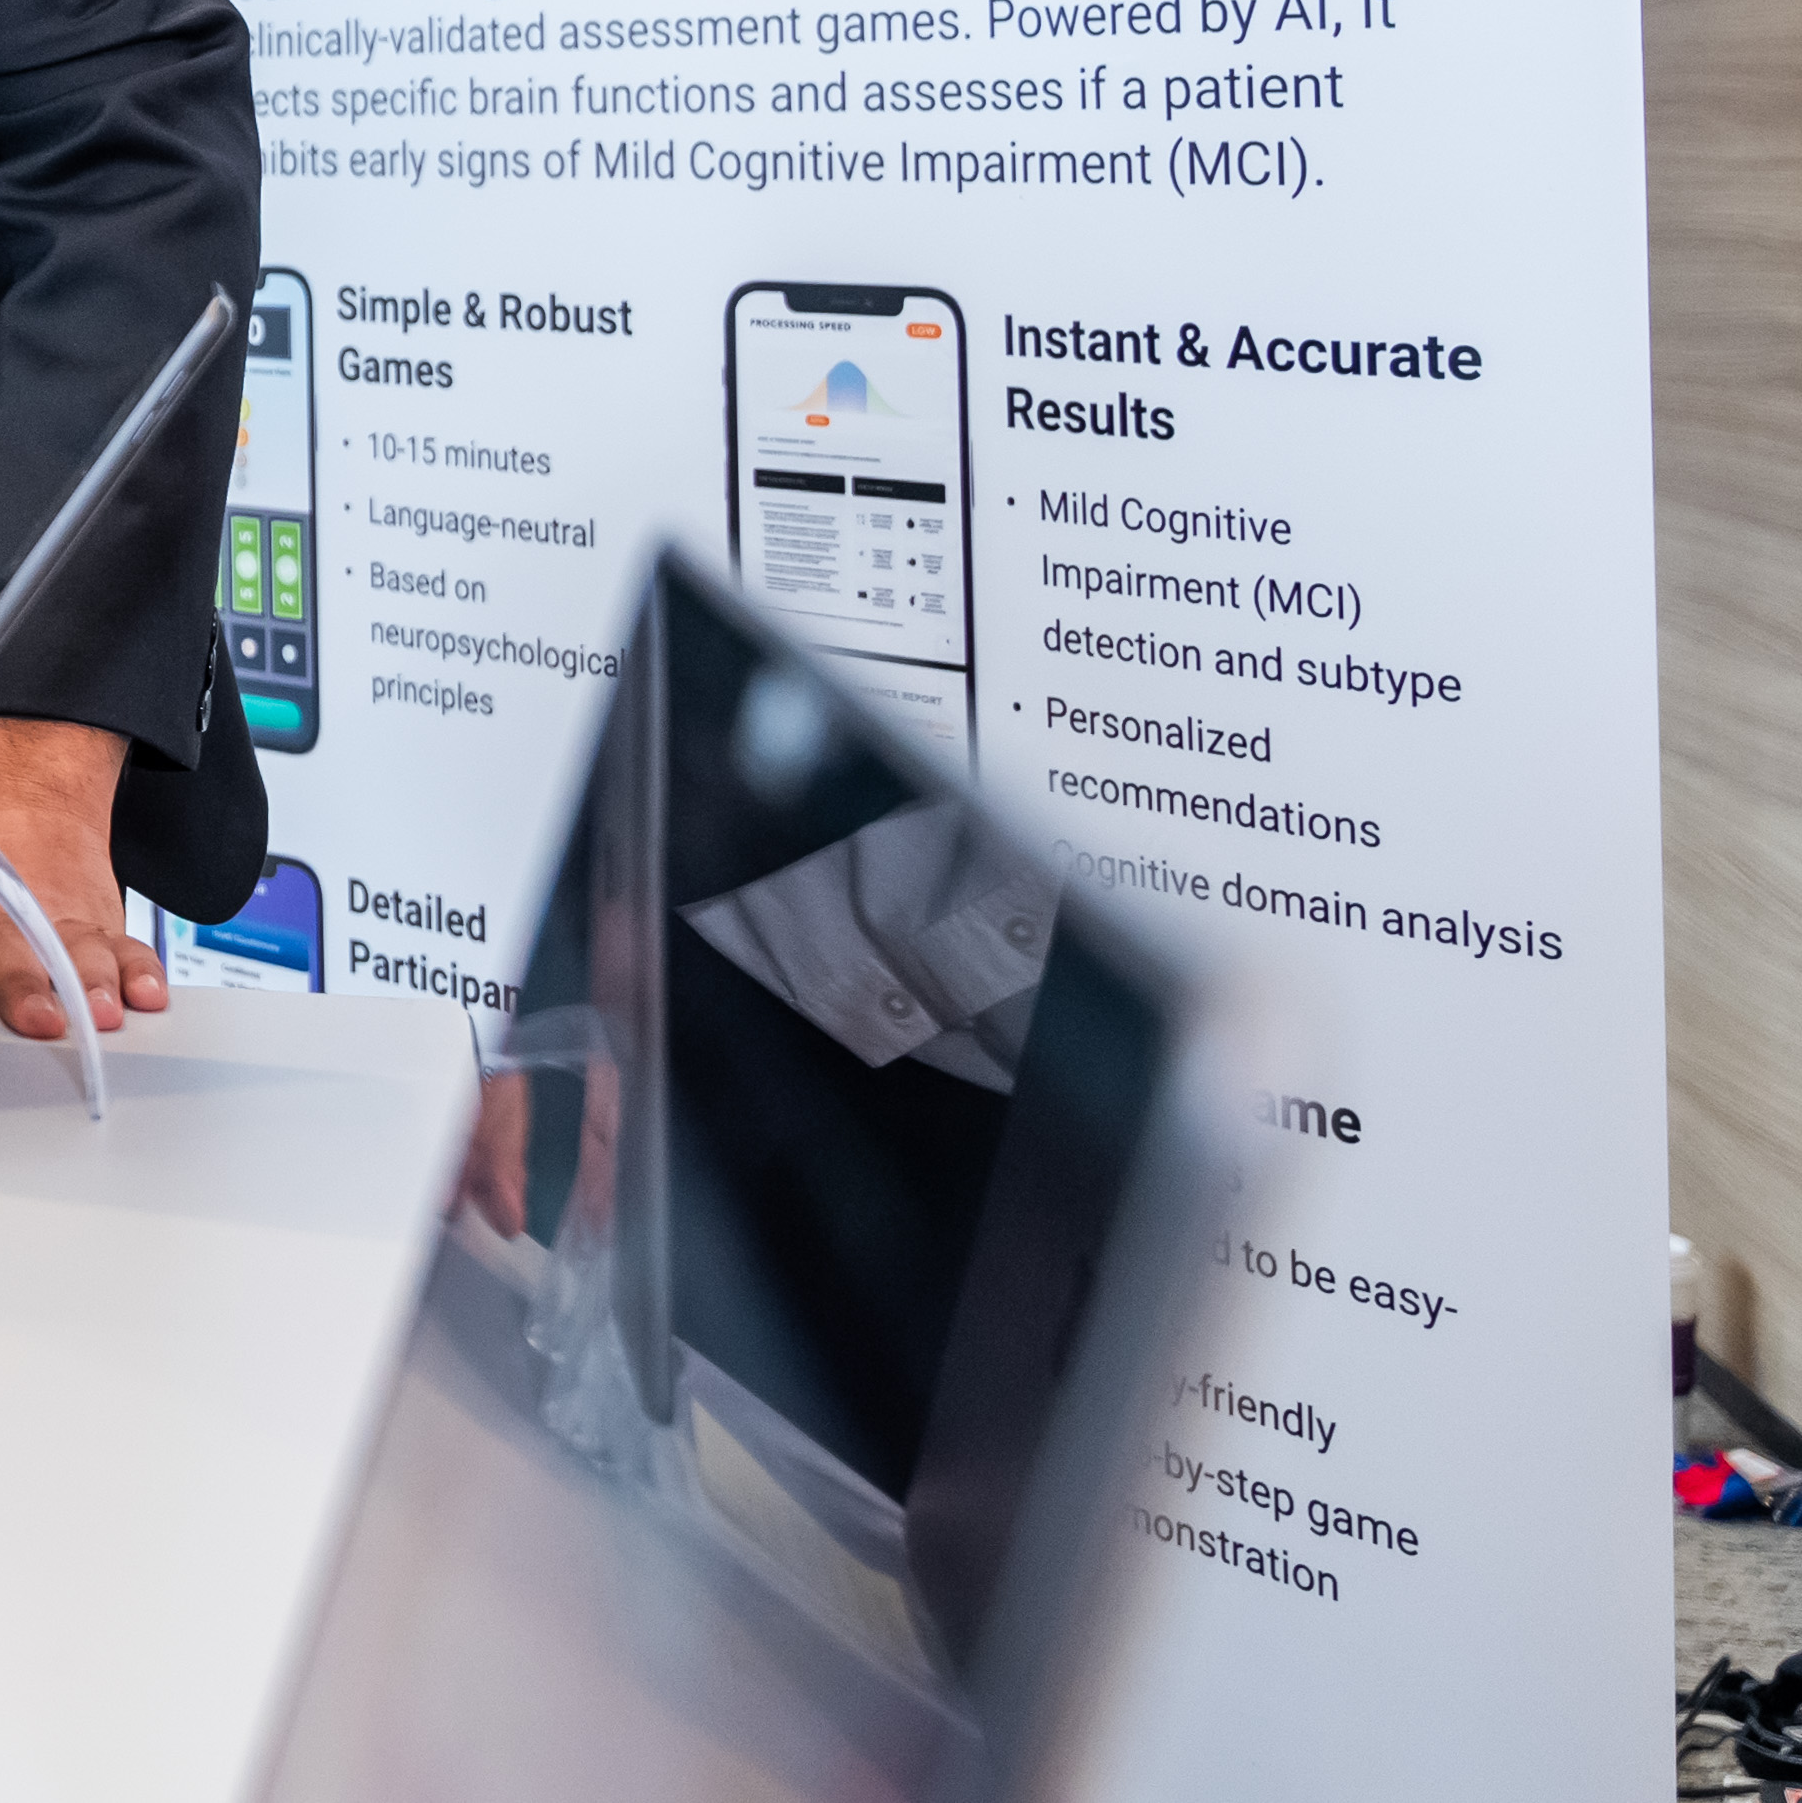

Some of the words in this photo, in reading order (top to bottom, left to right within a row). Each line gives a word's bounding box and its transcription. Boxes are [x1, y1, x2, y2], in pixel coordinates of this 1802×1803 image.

[559, 7, 801, 50] assessment
[816, 7, 972, 53] games.
[254, 85, 320, 117] ects
[331, 78, 458, 125] specific
[469, 79, 559, 116] brain
[572, 74, 756, 115] functions
[770, 70, 848, 113] and
[863, 77, 1064, 112] assesses
[1079, 64, 1106, 110] if
[1122, 76, 1148, 110] a
[1164, 64, 1344, 121] patient
[349, 141, 425, 187] early
[436, 142, 530, 188] signs
[543, 139, 582, 179] of
[594, 140, 675, 180] Mild
[688, 140, 885, 191] Cognitive
[901, 141, 1152, 193] Impairment
[1169, 135, 1325, 199] (MCI).
[337, 285, 452, 334] Simple
[463, 292, 487, 329] &
[498, 293, 633, 336] Robust
[750, 319, 815, 330] PROCESSING
[819, 322, 851, 331] SPEED
[337, 347, 454, 388] Games
[1003, 314, 1161, 366] Instant
[1176, 321, 1211, 368] &
[1226, 324, 1483, 381] Accurate
[1006, 386, 1176, 440] Results
[367, 431, 437, 466] 10-15
[444, 440, 552, 476] minutes
[368, 497, 596, 549] Language-neutral
[1040, 489, 1109, 528] Mild
[1120, 497, 1292, 546] Cognitive
[369, 561, 446, 598] Based
[453, 577, 486, 604] on
[1042, 554, 1240, 609] Impairment
[1253, 574, 1363, 631] (MCI)
[1043, 619, 1202, 672] detection
[1214, 646, 1283, 682] and
[1296, 654, 1463, 707] subtype
[371, 672, 494, 716] principles
[1046, 696, 1272, 762] Personalized
[1048, 767, 1382, 848] recommendations
[347, 877, 487, 943] Detailed
[1221, 873, 1368, 931] domain
[1381, 909, 1564, 961] analysis
[1241, 1239, 1278, 1279] to
[1290, 1248, 1337, 1294] be
[1349, 1274, 1459, 1330] easy-
[1307, 1497, 1420, 1557] game
